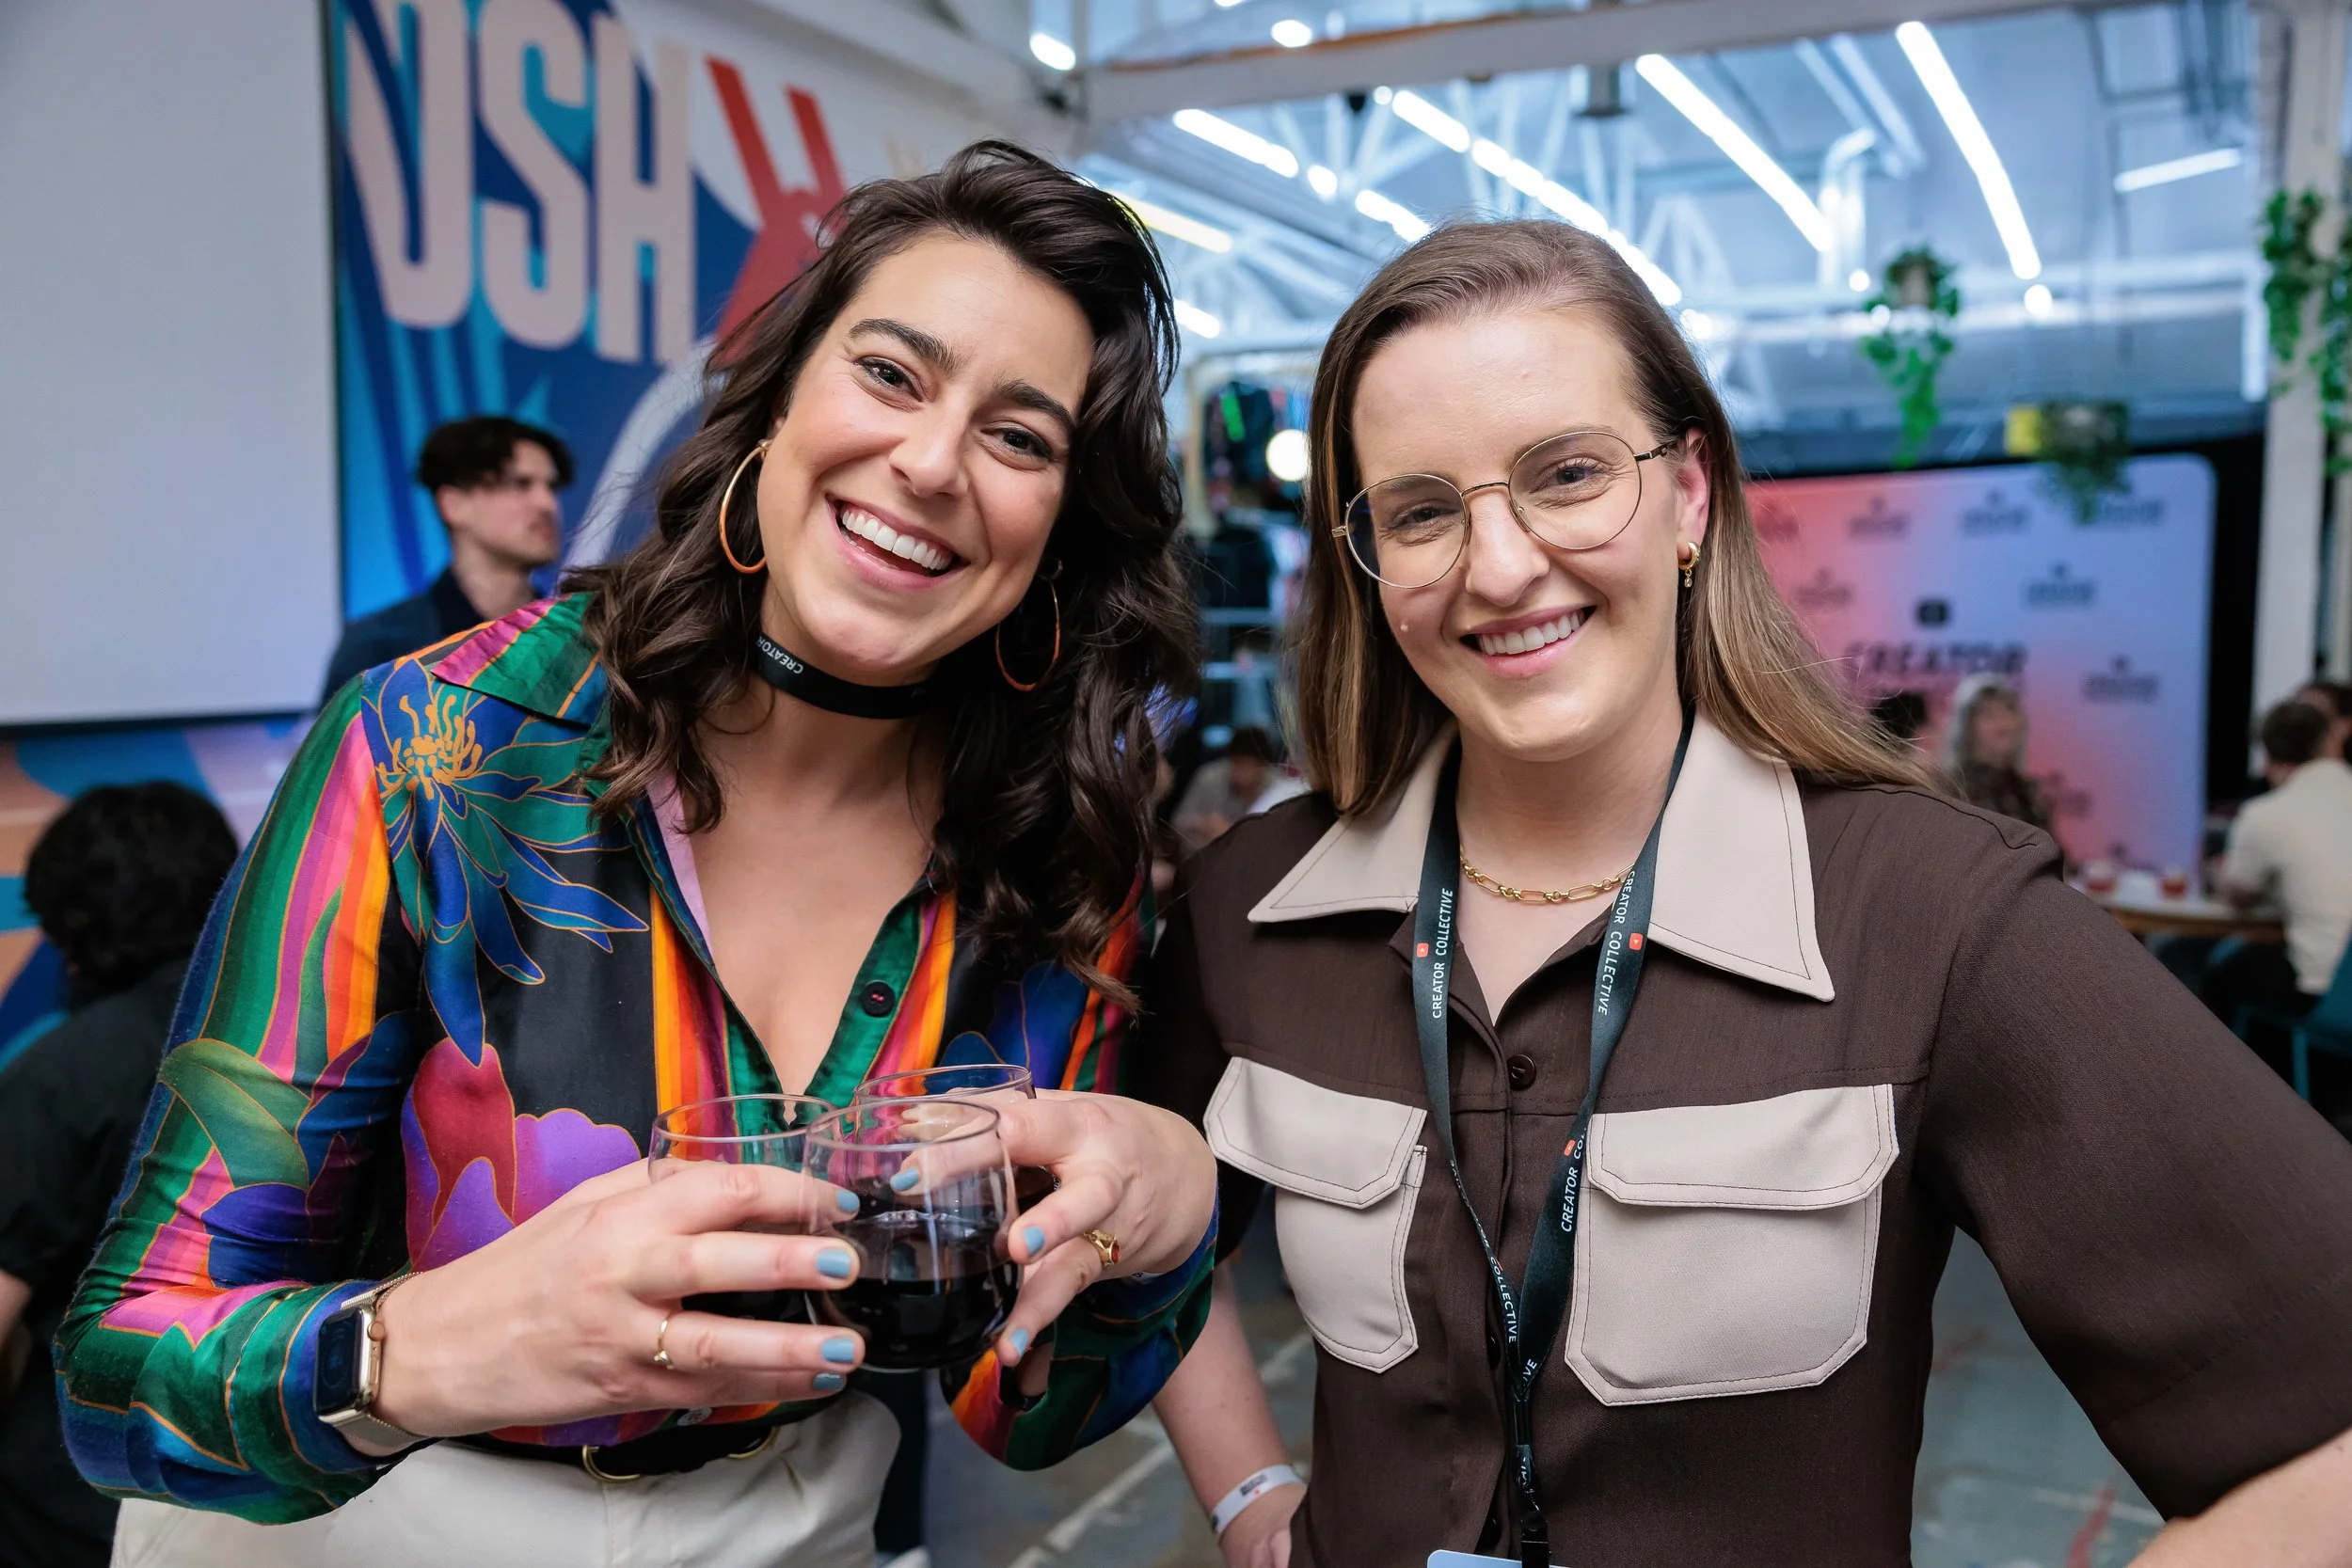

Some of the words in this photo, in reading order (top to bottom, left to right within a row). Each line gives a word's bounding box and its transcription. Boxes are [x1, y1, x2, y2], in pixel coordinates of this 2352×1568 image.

[755, 636, 804, 675] CREATOR
[1435, 888, 1454, 957] COLLECTIVE
[1614, 869, 1635, 925] CREATOR
[1432, 962, 1445, 1019] CREATOR
[1598, 931, 1623, 1016] COLLECTIVE
[1561, 1166, 1579, 1232] CREATOR
[1490, 1256, 1518, 1343] COLLECTIVE
